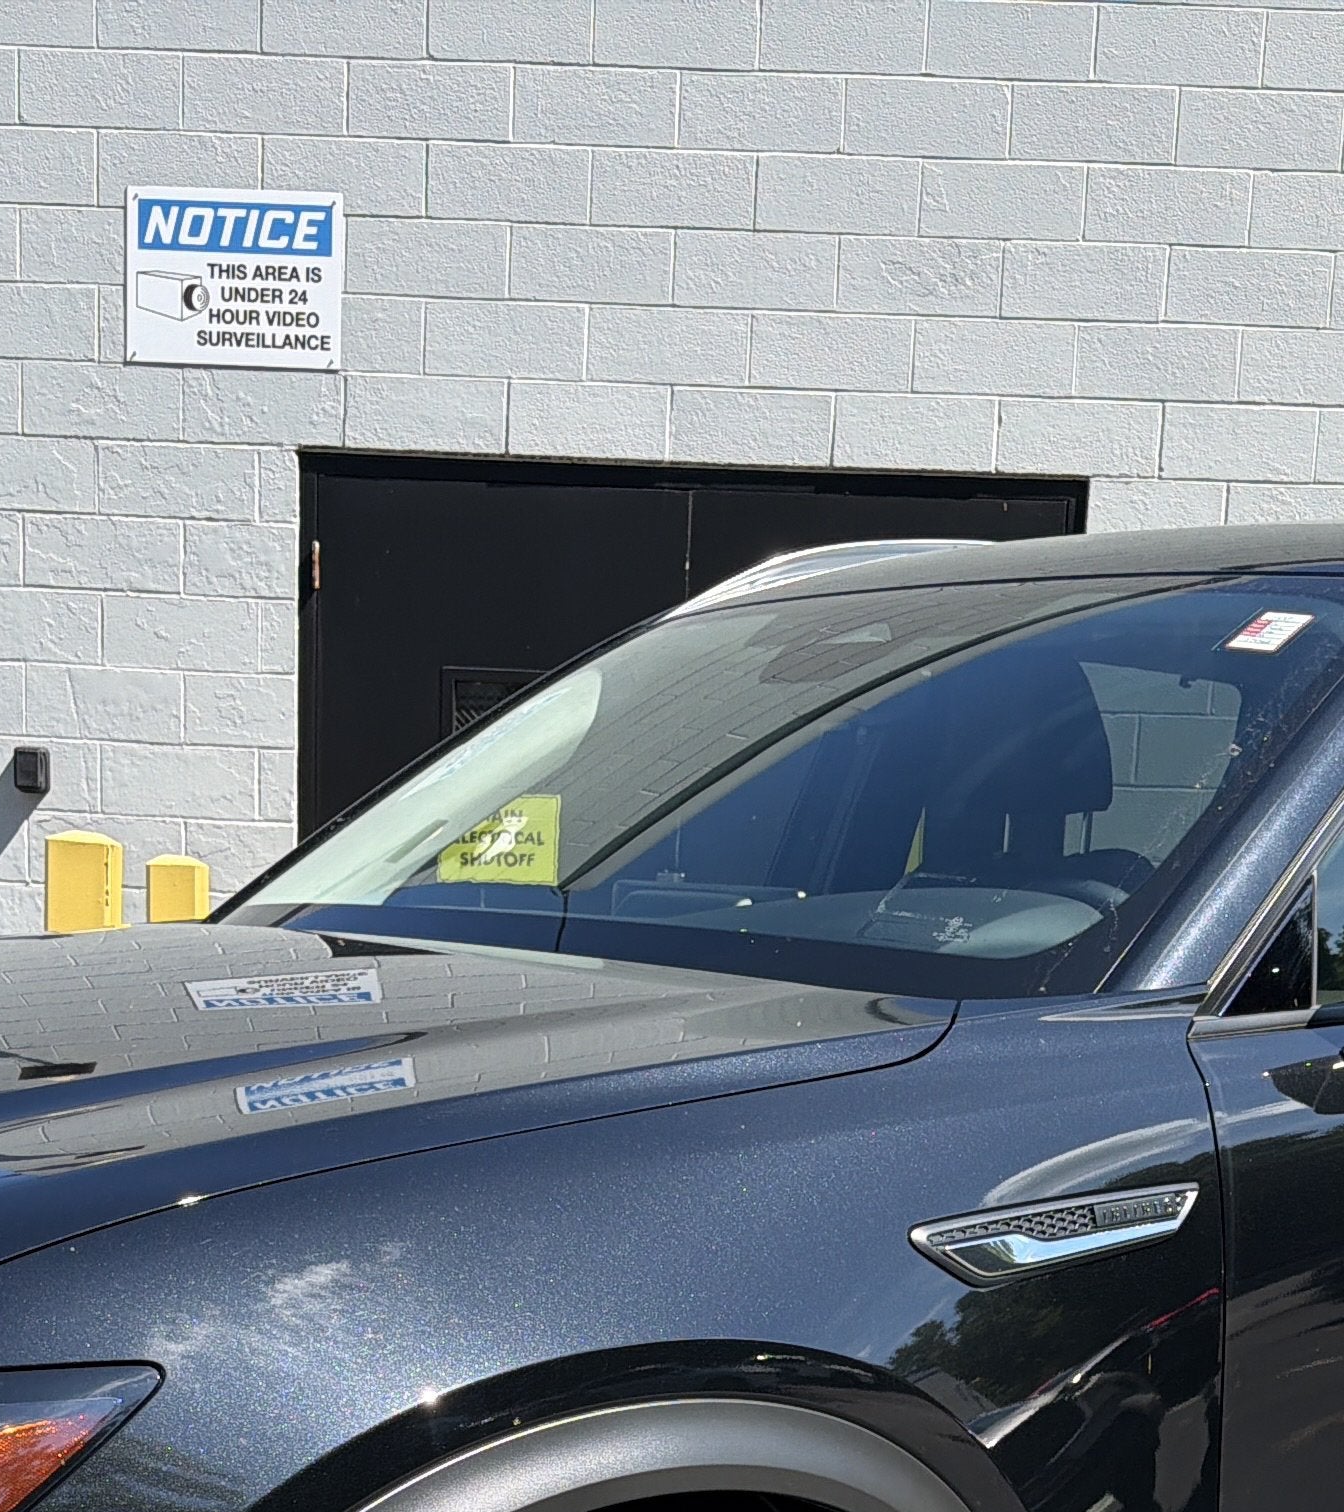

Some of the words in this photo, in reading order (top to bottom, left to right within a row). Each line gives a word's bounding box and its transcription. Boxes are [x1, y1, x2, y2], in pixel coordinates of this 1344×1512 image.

[143, 205, 327, 251] NOTICE
[206, 262, 248, 281] THIS
[251, 264, 301, 283] AREA
[305, 266, 323, 283] IS
[220, 285, 284, 305] UNDER
[288, 288, 309, 305] 24
[208, 307, 261, 326] HOUR
[265, 310, 320, 329] VIDEO
[196, 329, 332, 352] SURVEILLANCE
[487, 808, 524, 824] AIN
